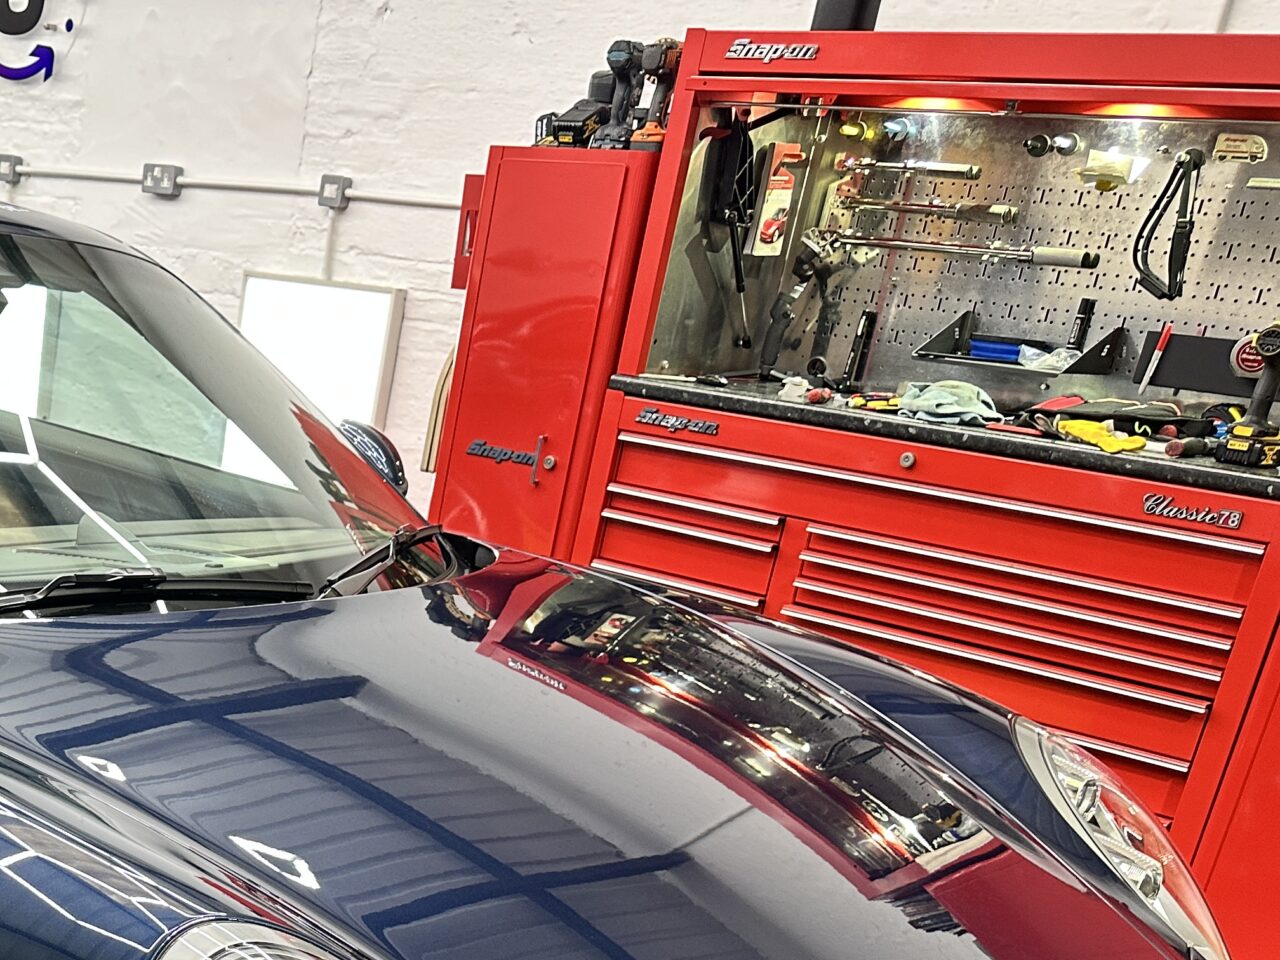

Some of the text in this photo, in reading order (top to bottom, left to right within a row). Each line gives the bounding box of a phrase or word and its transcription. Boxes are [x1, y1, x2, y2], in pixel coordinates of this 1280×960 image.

[724, 38, 820, 64] Snap-on
[635, 406, 719, 436] Snap-on
[466, 439, 536, 465] Snap-on
